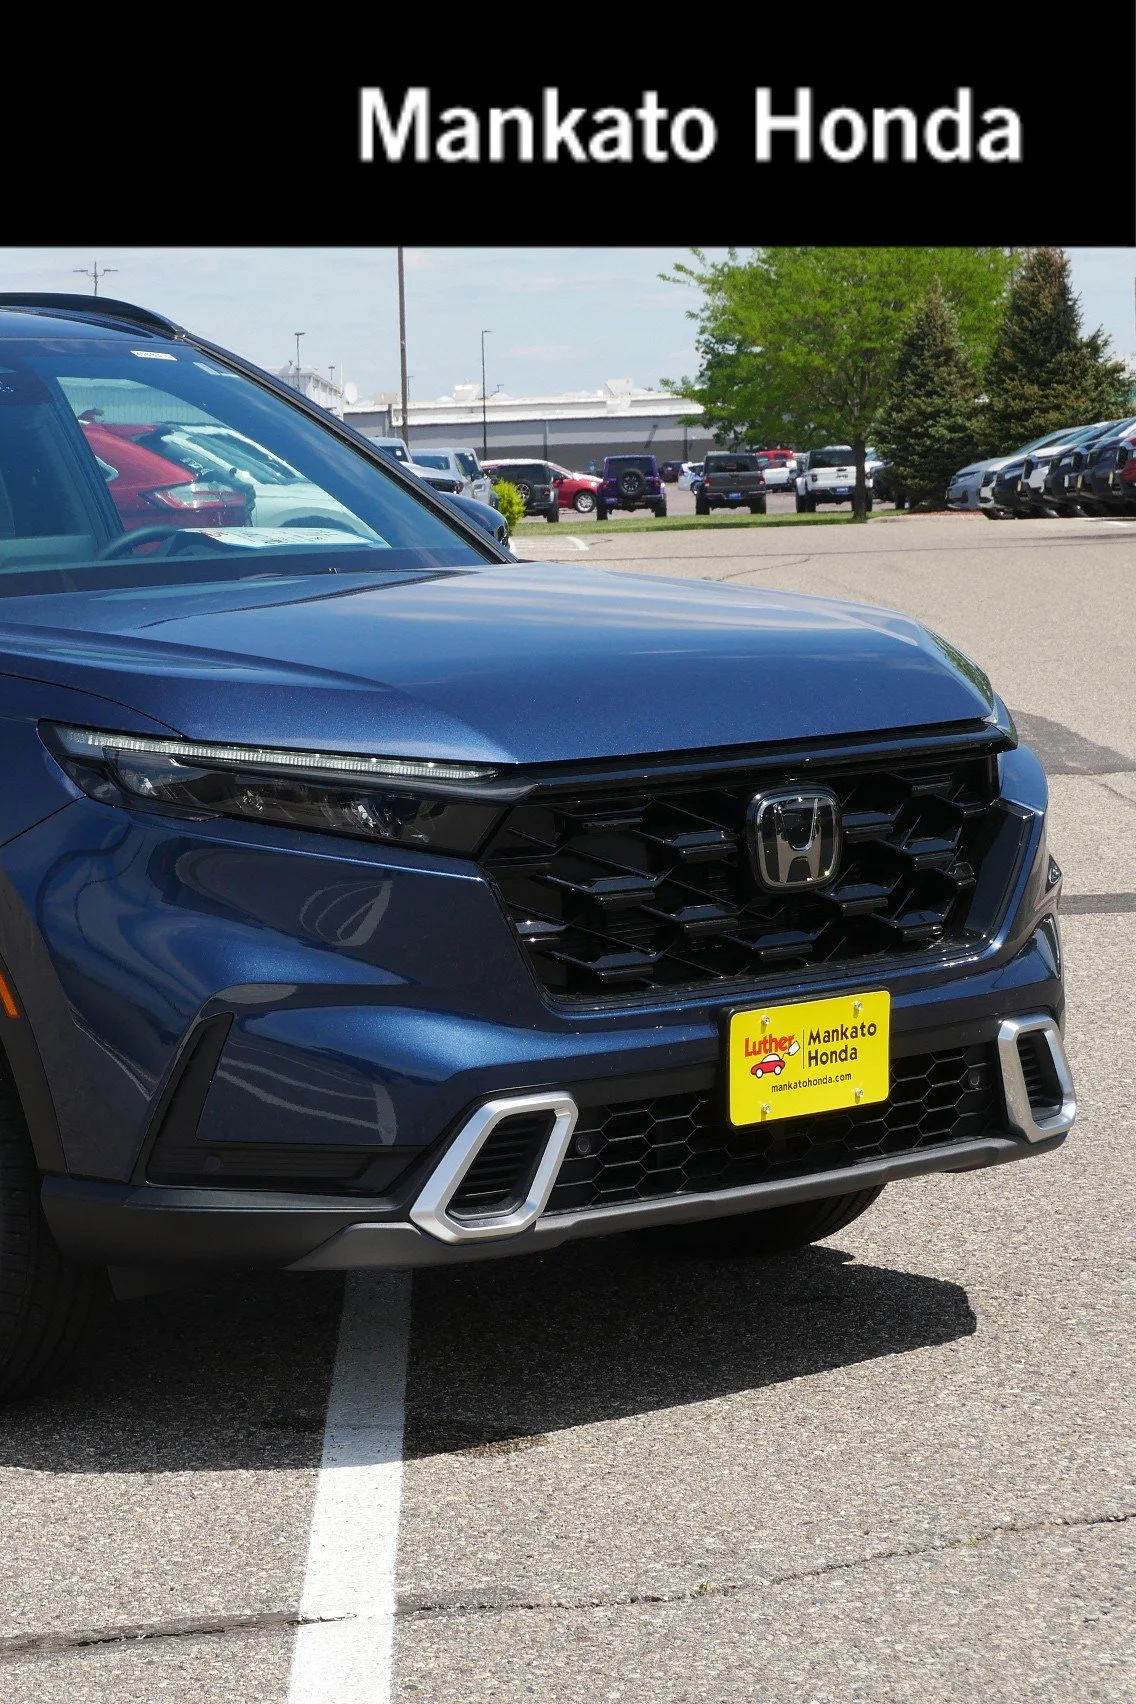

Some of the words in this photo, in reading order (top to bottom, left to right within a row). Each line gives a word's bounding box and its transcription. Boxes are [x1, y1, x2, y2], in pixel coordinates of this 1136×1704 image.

[744, 1033, 795, 1058] Luther
[807, 1021, 878, 1046] Mankato
[807, 1045, 859, 1068] Honda
[771, 1071, 853, 1093] mankatohonda.com
